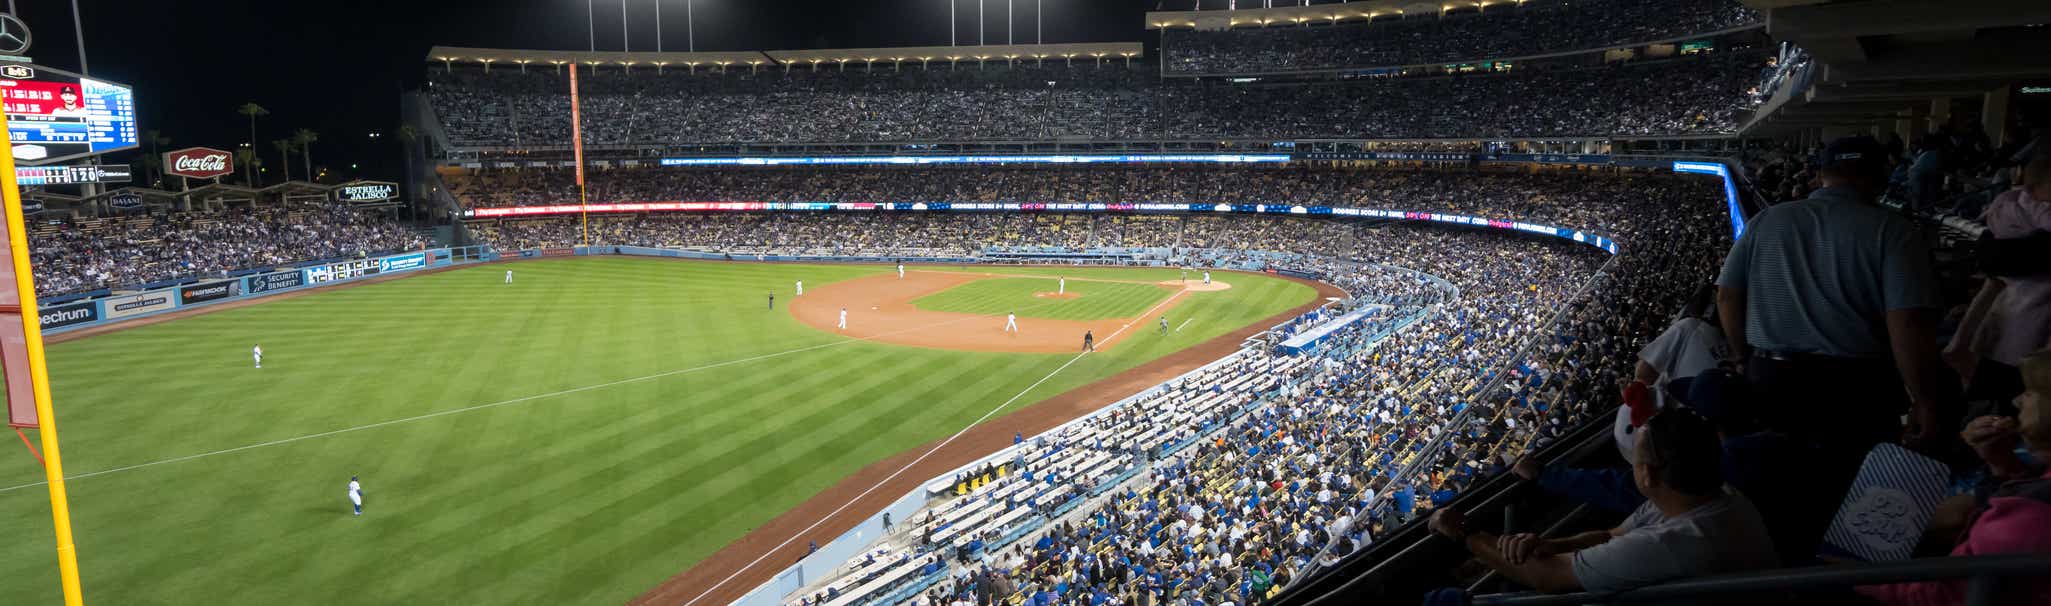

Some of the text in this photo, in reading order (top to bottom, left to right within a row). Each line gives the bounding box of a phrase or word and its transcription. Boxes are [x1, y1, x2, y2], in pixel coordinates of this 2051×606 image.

[175, 154, 227, 171] Coca-Cola
[72, 171, 78, 182] 1
[80, 171, 88, 182] 2
[88, 171, 96, 182] 0
[345, 185, 392, 195] ESTRELLA
[350, 191, 388, 200] JALISCO
[267, 271, 299, 283] SECURITY
